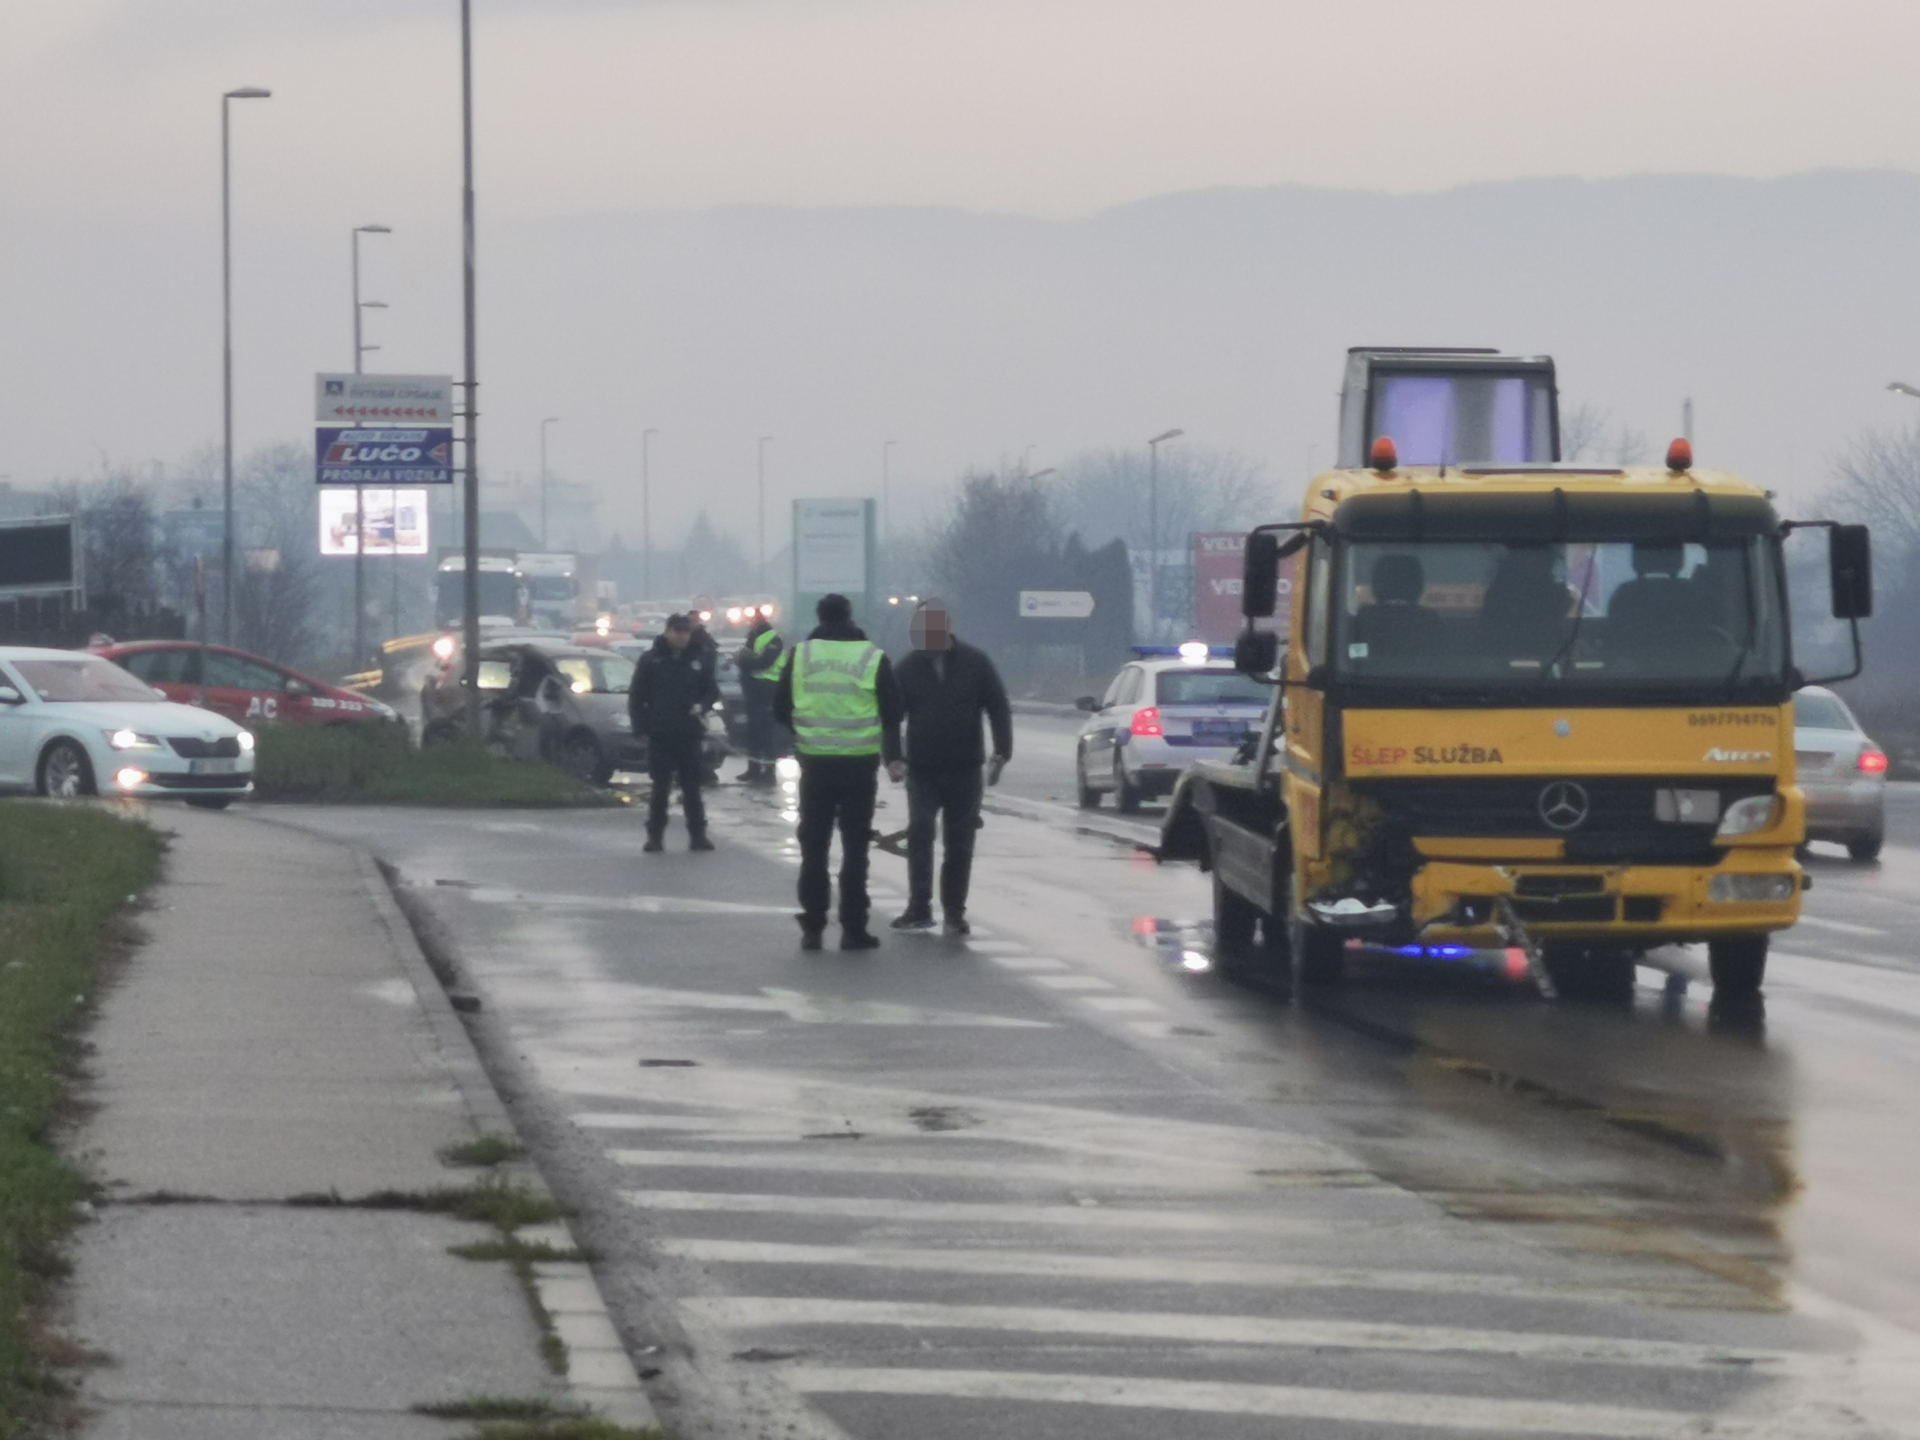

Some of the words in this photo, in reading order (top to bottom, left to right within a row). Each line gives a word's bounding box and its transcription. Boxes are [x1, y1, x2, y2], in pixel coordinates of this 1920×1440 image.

[322, 469, 391, 481] PRODAJA
[394, 469, 448, 481] VOZILA
[1350, 743, 1407, 765] ŠLEP
[1413, 743, 1503, 764] SLUŽBA
